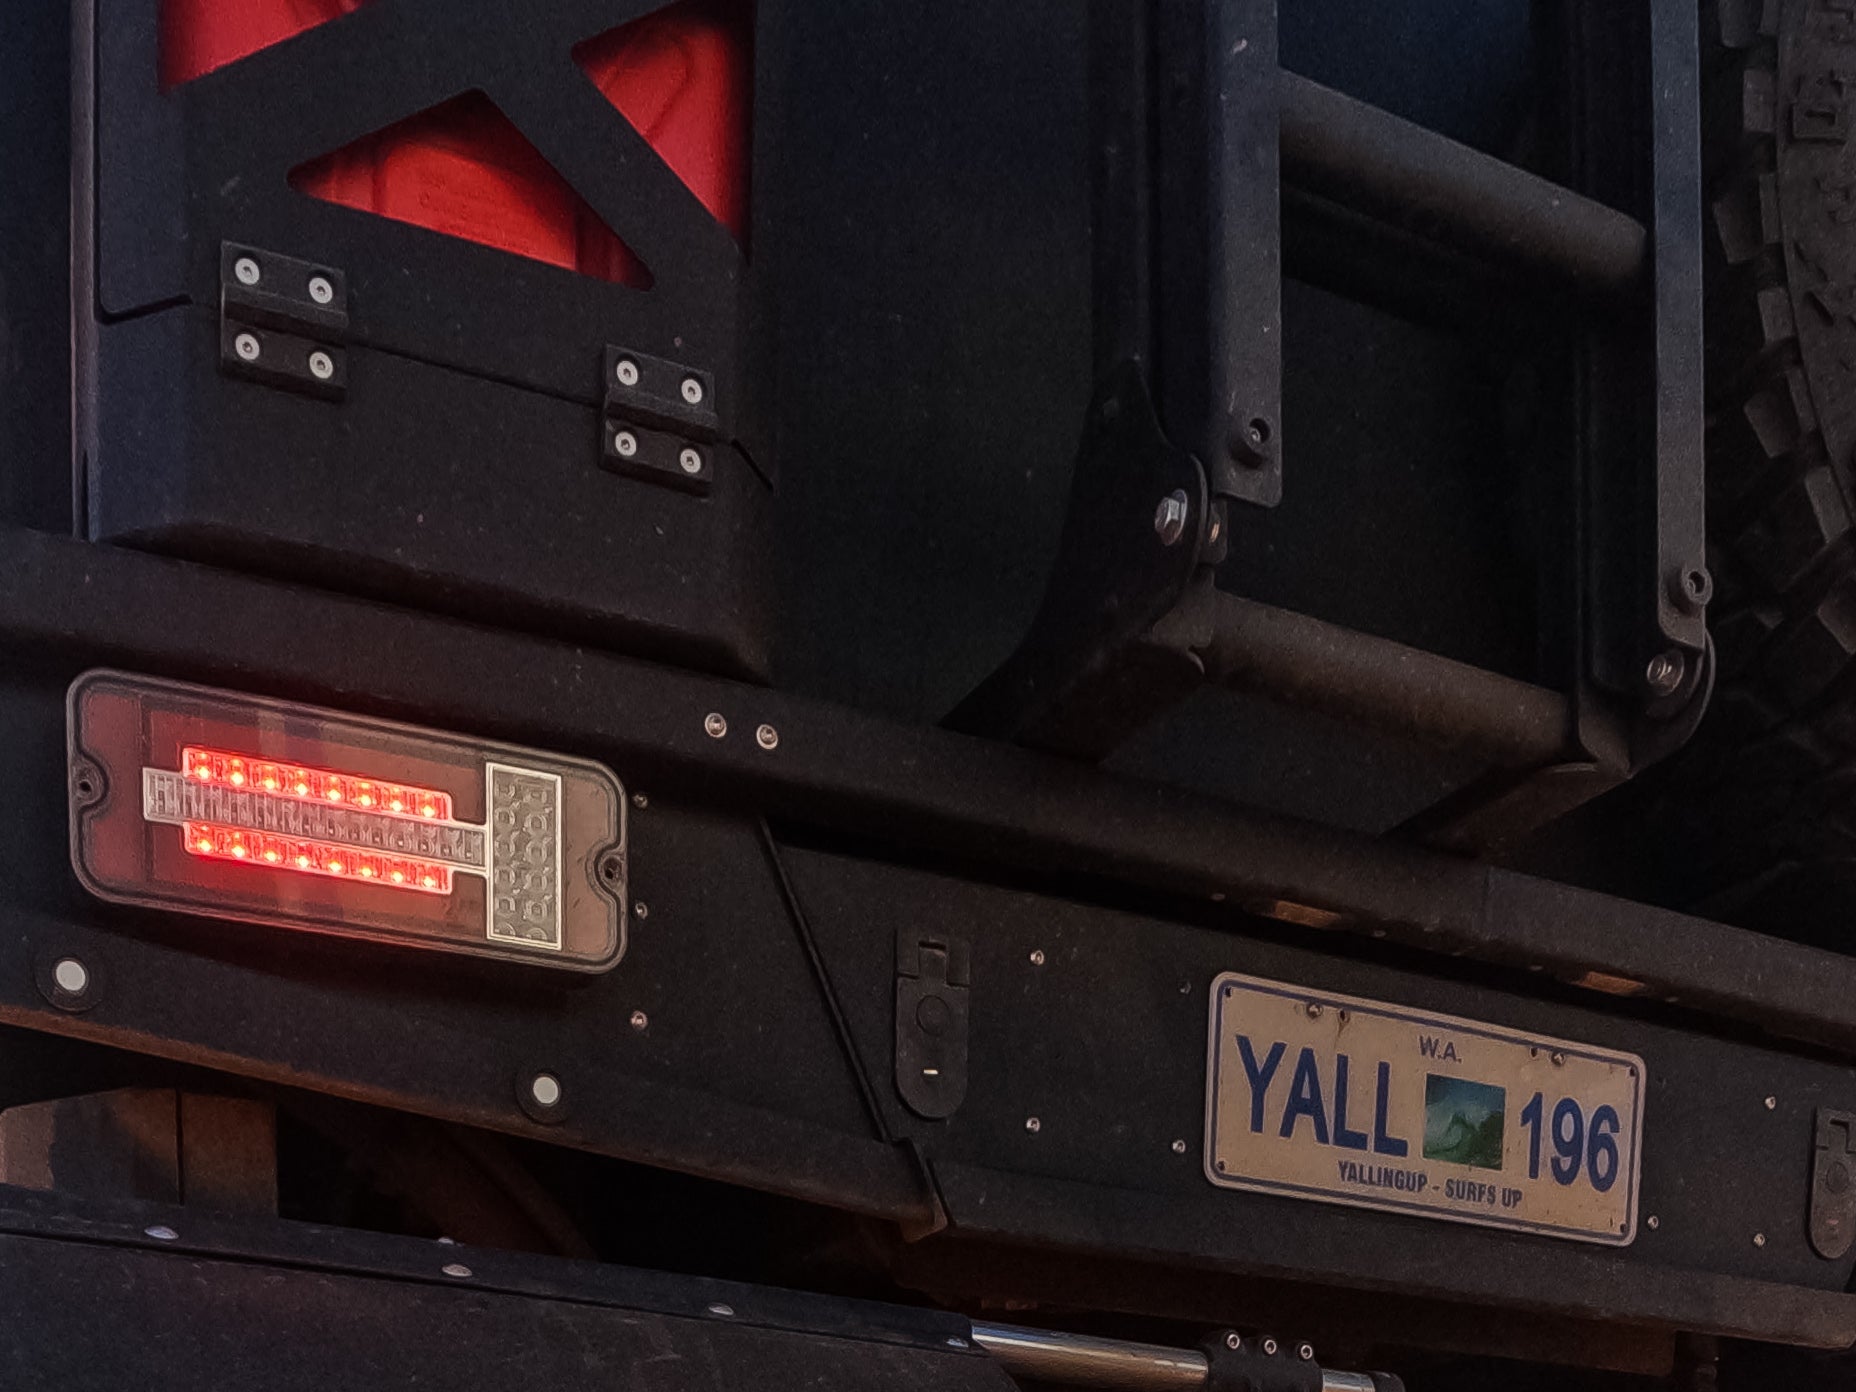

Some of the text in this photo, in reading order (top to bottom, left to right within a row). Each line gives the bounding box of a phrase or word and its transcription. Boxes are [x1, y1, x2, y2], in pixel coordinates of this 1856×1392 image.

[1417, 1034, 1462, 1063] W.A.
[1234, 1034, 1620, 1192] YALL 196
[1337, 1160, 1429, 1194] YALLINGUP
[1444, 1177, 1497, 1206] SURFS
[1501, 1186, 1523, 1210] UP
